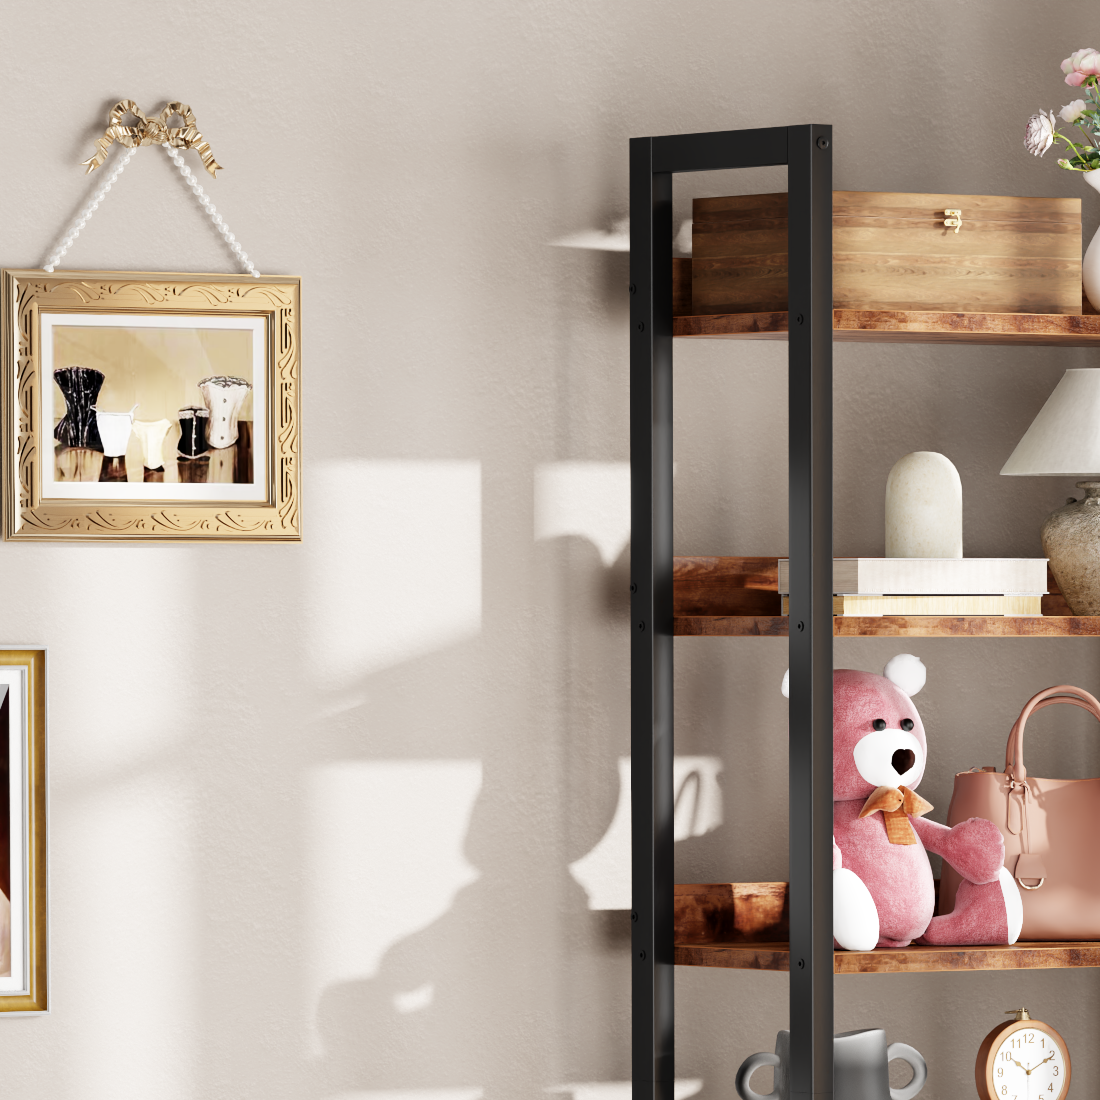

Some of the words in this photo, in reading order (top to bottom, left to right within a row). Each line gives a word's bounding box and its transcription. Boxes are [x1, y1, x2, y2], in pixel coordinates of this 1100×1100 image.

[1010, 1038, 1021, 1049] 11
[1023, 1033, 1035, 1044] 12
[1000, 1051, 1012, 1062] 10
[1049, 1050, 1056, 1061] 2
[997, 1067, 1004, 1078] 9
[1052, 1065, 1059, 1077] 3
[1001, 1084, 1008, 1096] 8
[1047, 1082, 1054, 1093] 4
